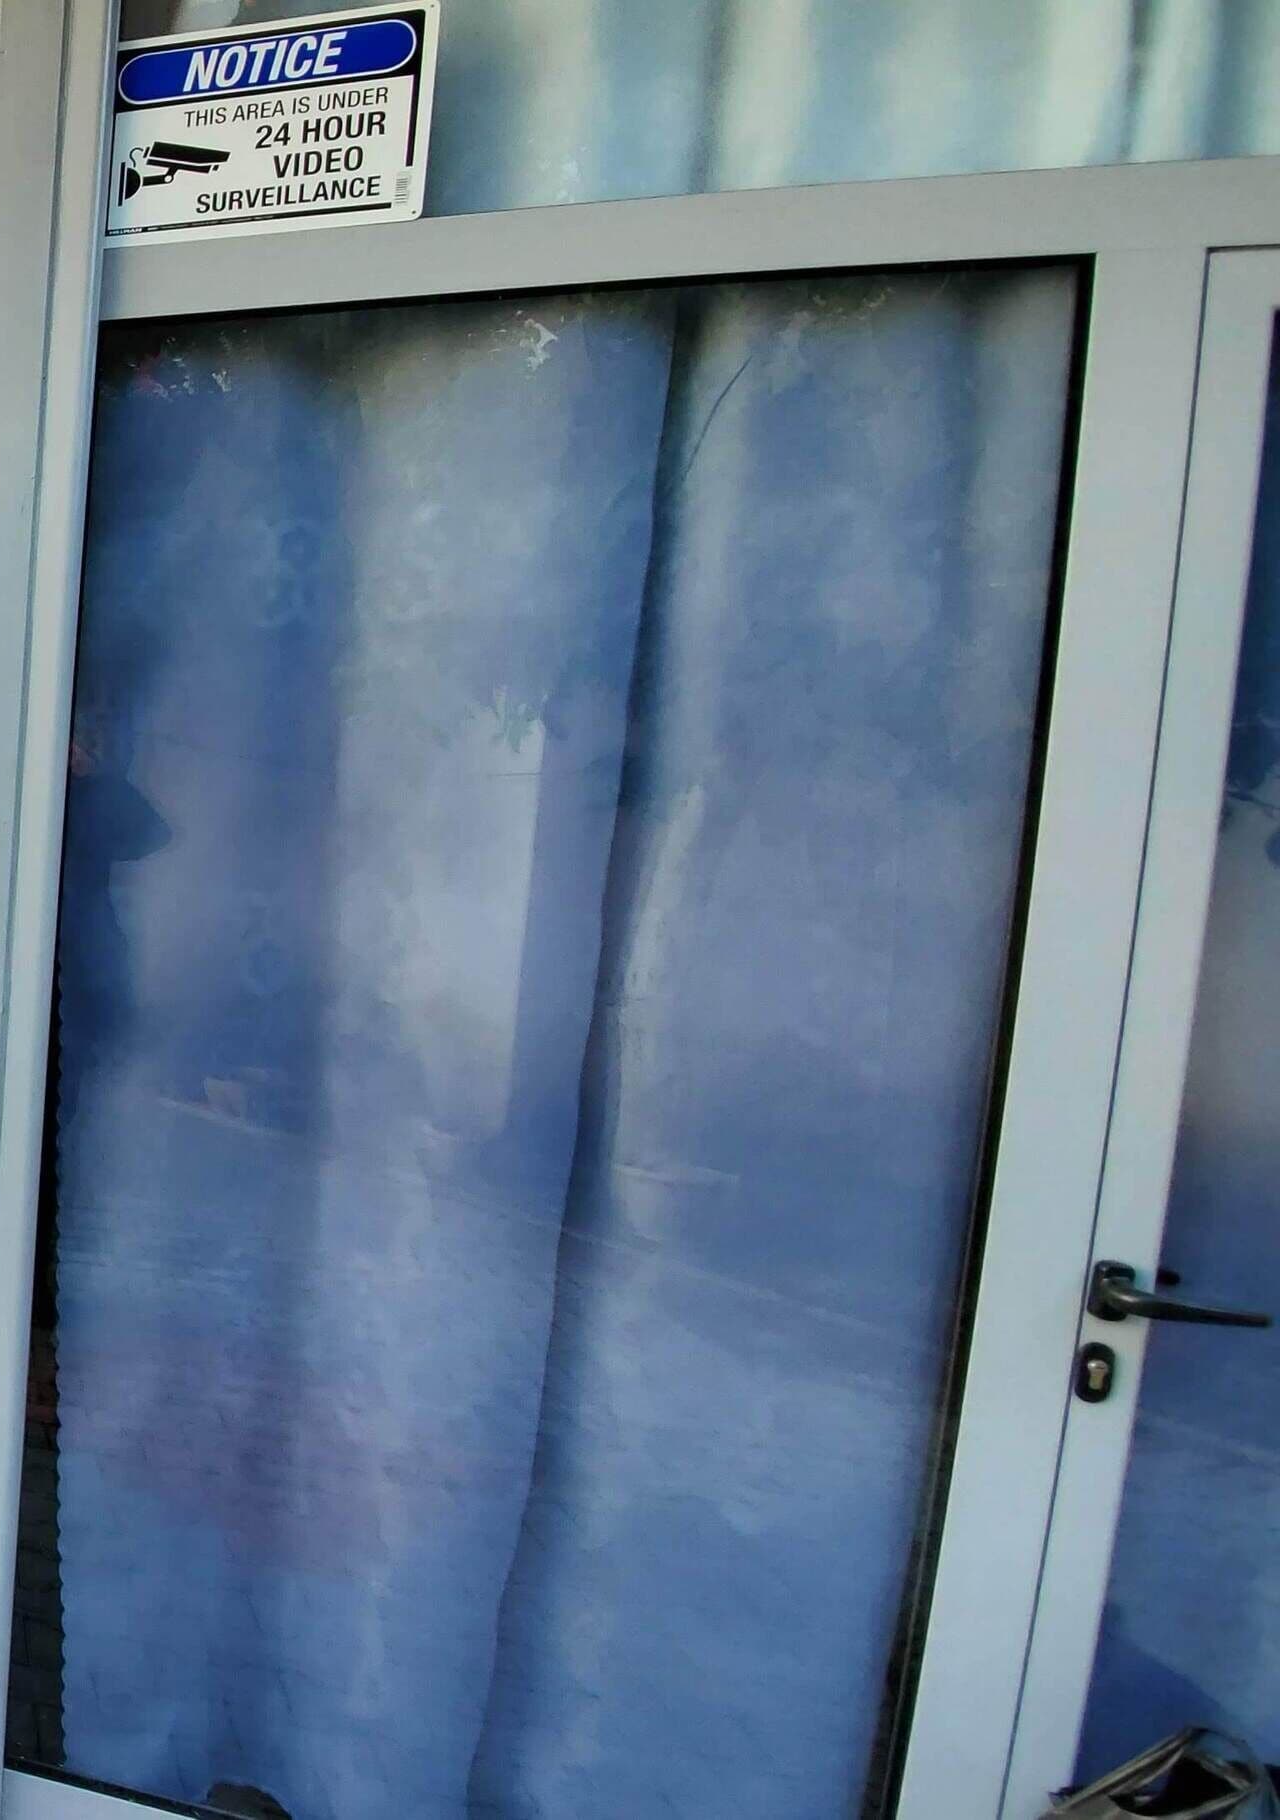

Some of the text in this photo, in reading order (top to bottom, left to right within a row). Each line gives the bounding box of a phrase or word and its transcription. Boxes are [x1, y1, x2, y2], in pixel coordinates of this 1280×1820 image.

[183, 31, 347, 92] NOTICE
[184, 87, 389, 127] THIS AREA IS UNDER
[255, 111, 386, 149] 24 HOUR
[273, 146, 364, 178] VIDEO
[196, 176, 381, 214] SURVEILLANCE
